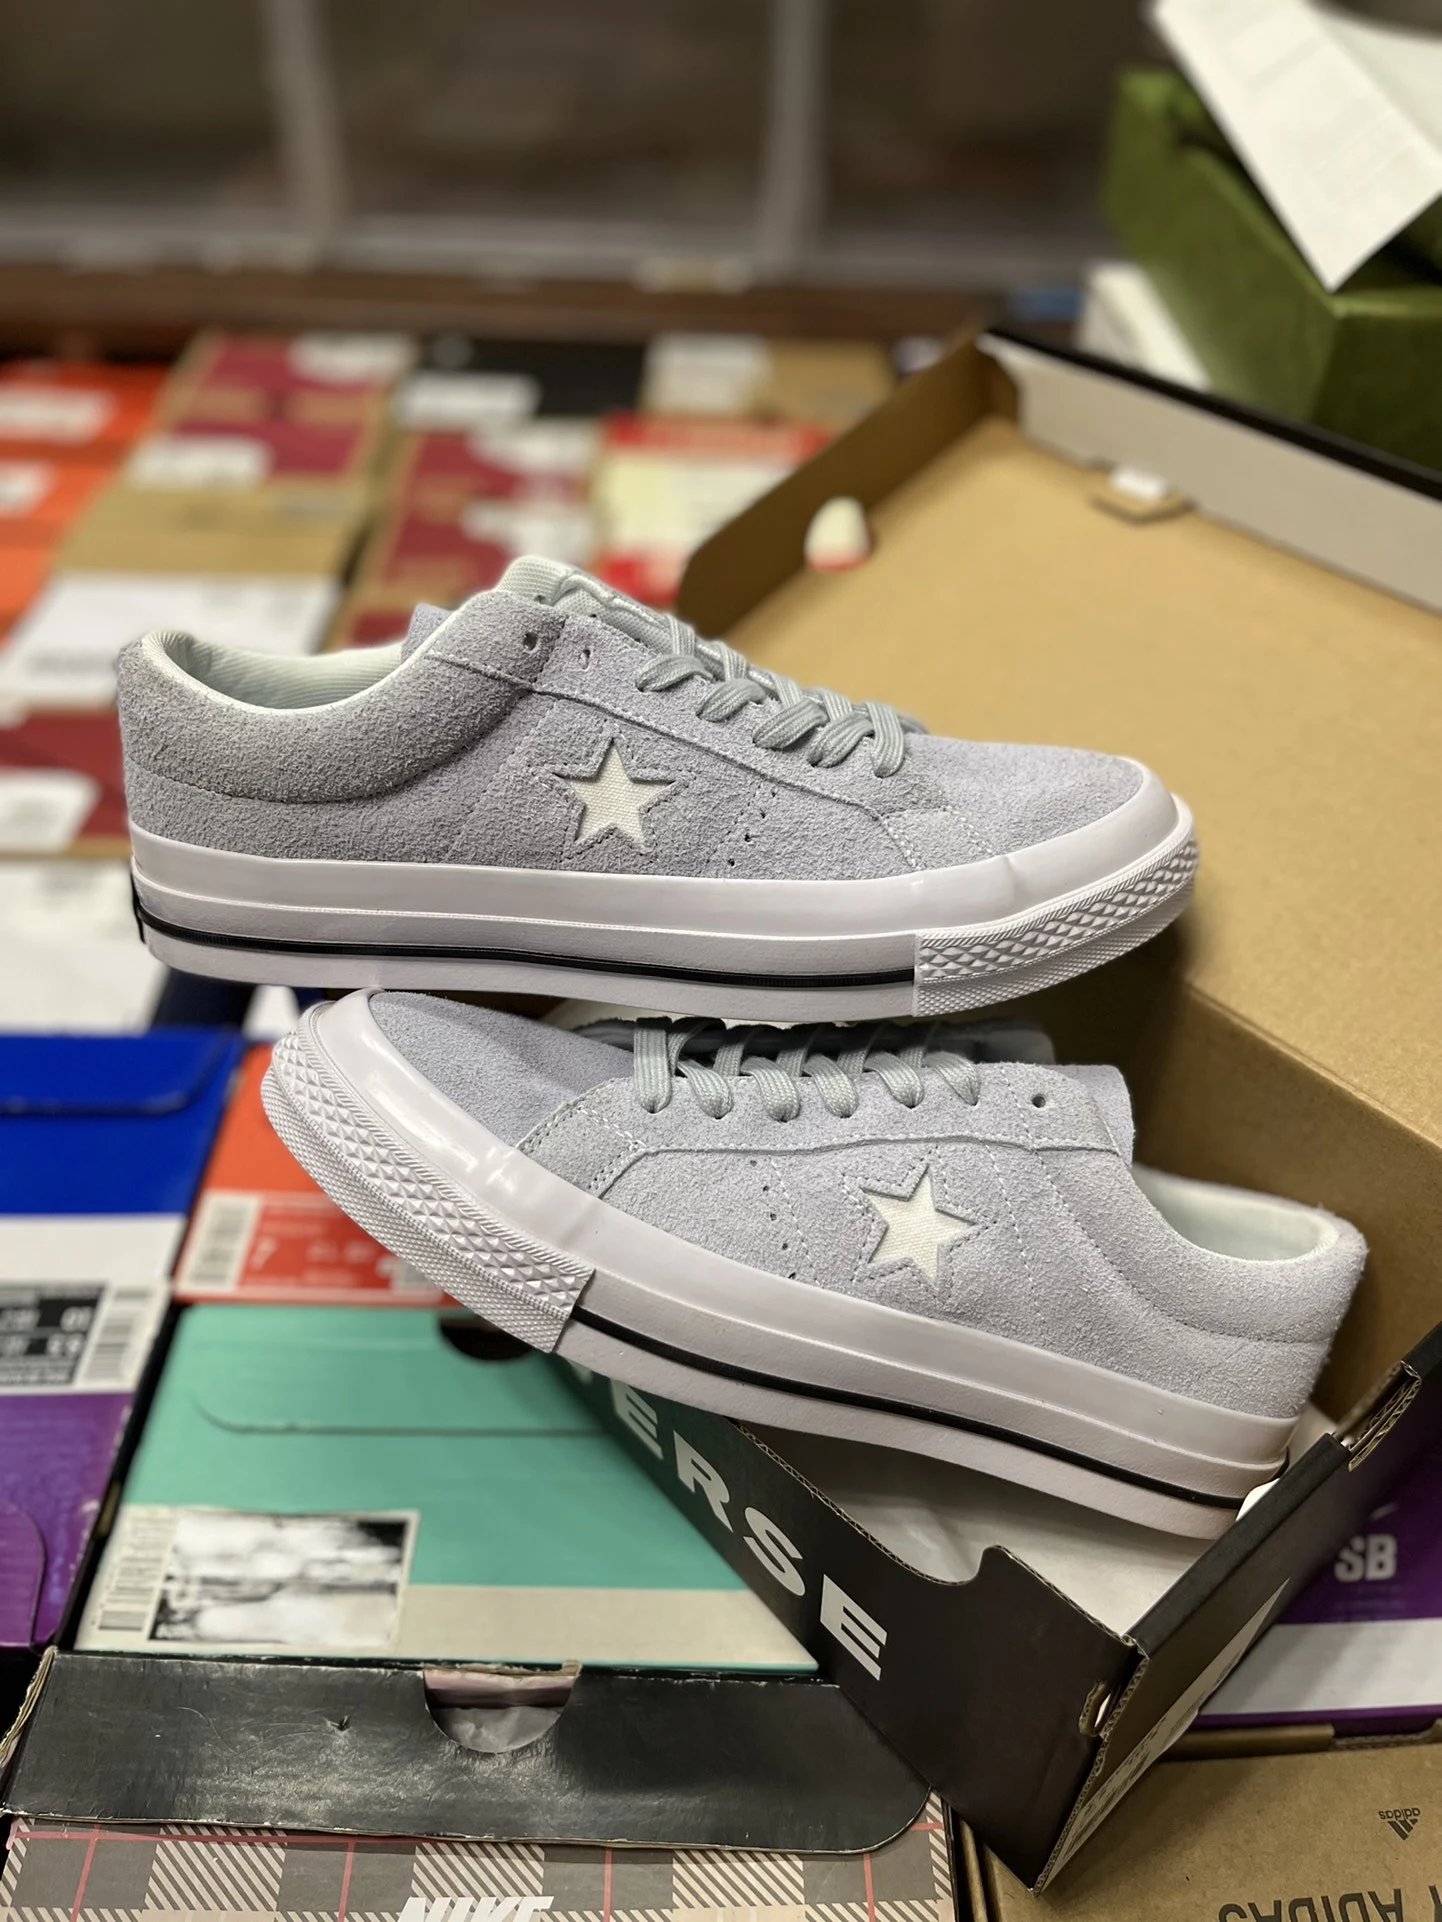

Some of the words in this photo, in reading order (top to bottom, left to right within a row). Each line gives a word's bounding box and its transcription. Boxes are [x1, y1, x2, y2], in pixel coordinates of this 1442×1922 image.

[570, 1361, 888, 1682] ERSE
[1333, 1533, 1398, 1582] SB
[1378, 1807, 1421, 1821] adidas
